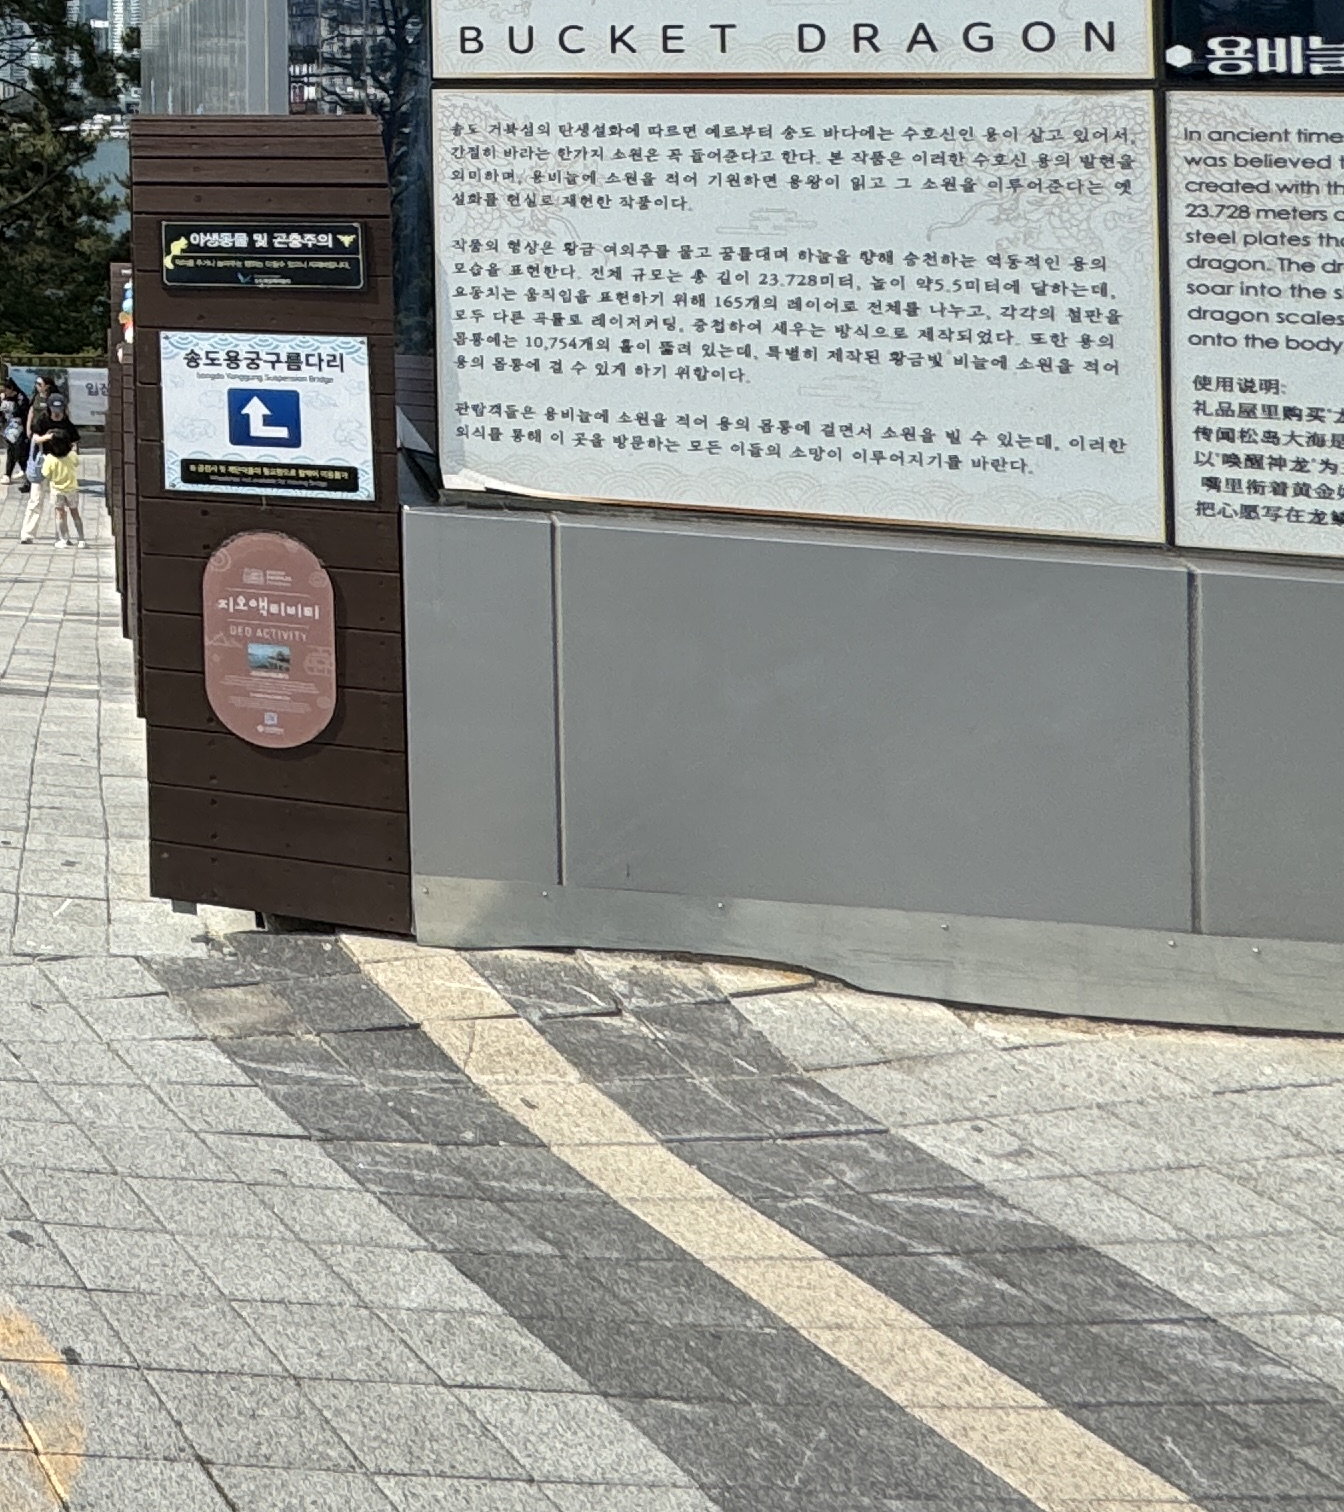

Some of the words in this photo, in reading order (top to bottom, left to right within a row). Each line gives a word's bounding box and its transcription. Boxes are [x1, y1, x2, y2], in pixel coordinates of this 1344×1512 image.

[459, 24, 737, 55] BUCKET
[796, 20, 1116, 53] DRAGON
[451, 122, 479, 136] 송도
[647, 124, 697, 139] 따르면
[704, 124, 773, 139] 예로부터
[780, 125, 816, 140] 송도
[822, 125, 895, 141] 바다에는
[901, 126, 975, 141] 수호신인
[982, 127, 1018, 142] 용이
[1184, 127, 1201, 141] In
[1208, 127, 1290, 142] ancient
[451, 145, 496, 159] 간절히
[503, 146, 550, 160] 바라는
[557, 146, 604, 161] 한가지
[612, 147, 659, 162] 소원은
[666, 149, 683, 162] 꼭
[689, 149, 774, 163] 들어준다고
[827, 151, 844, 165] 본
[851, 151, 904, 166] 작품은
[912, 151, 966, 167] 이러한
[972, 152, 1027, 167] 수호신
[1036, 153, 1070, 168] 용의
[1184, 155, 1227, 168] was
[1234, 154, 1331, 169] believed
[531, 170, 596, 185] 용비늘에
[604, 171, 656, 186] 소원을
[665, 171, 698, 187] 적어
[708, 173, 778, 188] 기원하면
[787, 175, 840, 189] 용왕이
[894, 178, 913, 189] 그
[921, 177, 978, 193] 소원을
[987, 177, 1104, 195] 이루어준다는
[1185, 179, 1270, 194] created
[1275, 180, 1320, 195] with
[452, 192, 499, 207] 설화를
[506, 192, 555, 208] 현실로
[561, 194, 613, 209] 재현한
[1185, 203, 1250, 219] 23.728
[1256, 206, 1328, 221] meters
[253, 233, 268, 248] 및
[1185, 229, 1236, 244] steel
[1243, 231, 1311, 247] plates
[450, 238, 499, 253] 작품의
[507, 239, 554, 255] 형상은
[562, 241, 596, 256] 황금
[603, 243, 671, 259] 여의주를
[677, 245, 712, 259] 물고
[797, 248, 851, 264] 하늘을
[986, 253, 1060, 270] 역동적인
[1069, 256, 1107, 272] 용의
[1186, 255, 1272, 273] dragon.
[1277, 257, 1316, 273] The
[452, 262, 501, 277] 모습을
[590, 266, 622, 280] 전체
[632, 268, 682, 283] 규모는
[717, 270, 749, 285] 길이
[870, 276, 905, 290] 높이
[916, 276, 1020, 294] 약5.5미터에
[1186, 282, 1234, 295] soar
[1240, 281, 1282, 297] into
[1290, 283, 1327, 299] the
[453, 286, 518, 301] 요동치는
[598, 291, 664, 306] 표현하기
[672, 292, 706, 307] 위해
[715, 295, 778, 310] 165개의
[787, 297, 859, 313] 레이어로
[867, 300, 921, 317] 전체를
[1000, 305, 1055, 321] 각각의
[1187, 306, 1269, 325] dragon
[1275, 310, 1344, 326] scales
[452, 309, 485, 322] 모두
[492, 309, 526, 325] 다른
[692, 318, 762, 334] 중첩하여
[772, 321, 826, 337] 세우는
[834, 323, 909, 339] 방식으로
[1030, 332, 1069, 347] 또한
[1078, 333, 1114, 349] 용의
[453, 332, 518, 348] 몸통에는
[765, 346, 818, 361] 특별히
[826, 347, 880, 364] 제작된
[953, 353, 1008, 370] 비늘에
[1015, 357, 1074, 374] 소원을
[1082, 359, 1120, 375] 적어
[1188, 333, 1238, 347] onto
[1244, 334, 1279, 349] the
[1285, 335, 1343, 355] body
[183, 349, 345, 373] 송도용궁구름다리
[455, 355, 484, 369] 용의
[491, 357, 541, 372] 몸통에
[549, 359, 564, 374] 걸
[570, 361, 587, 375] 수
[594, 361, 626, 376] 있게
[634, 363, 667, 379] 하기
[544, 407, 609, 423] 용비늘에
[618, 412, 668, 427] 소원을
[675, 414, 708, 429] 적어
[716, 416, 750, 431] 용의
[757, 419, 811, 435] 몸통에
[820, 422, 872, 439] 걸면서
[881, 427, 937, 443] 소원을
[945, 429, 962, 444] 빌
[969, 431, 988, 445] 수
[1068, 435, 1128, 454] 이러한
[510, 429, 542, 443] 통해
[550, 430, 564, 445] 이
[572, 433, 605, 448] 곳을
[612, 435, 681, 452] 방문하는
[687, 441, 722, 455] 모든
[730, 442, 781, 458] 이들의
[789, 446, 842, 461] 소망이
[852, 449, 963, 470] 이루어지기를
[255, 628, 308, 643] ACTIVITY
